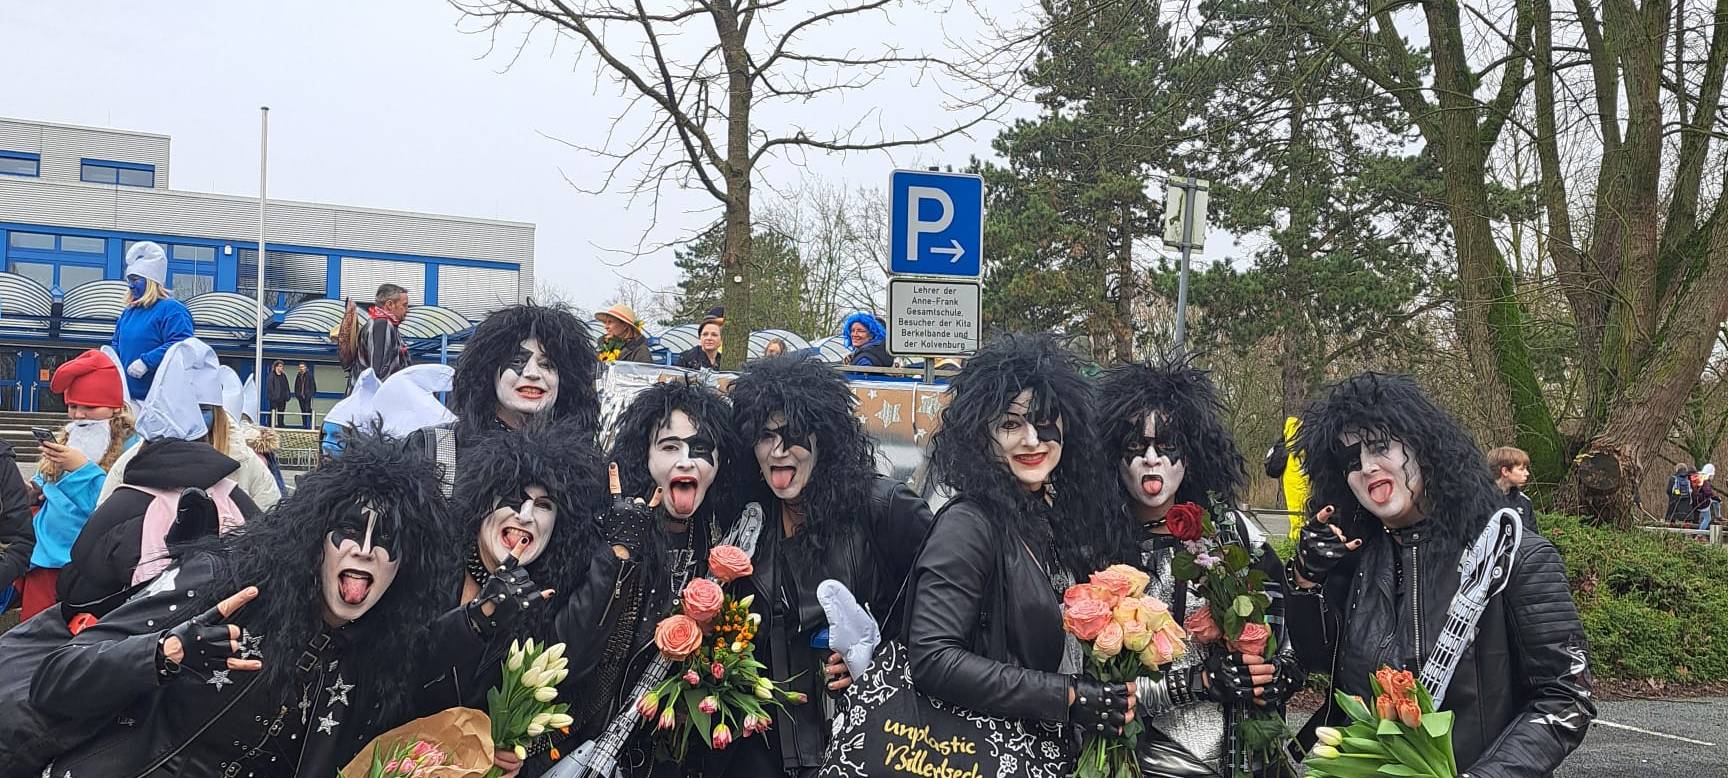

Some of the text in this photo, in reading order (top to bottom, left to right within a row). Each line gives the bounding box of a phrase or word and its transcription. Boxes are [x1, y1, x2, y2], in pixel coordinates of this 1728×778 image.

[907, 186, 955, 261] P
[913, 285, 957, 295] Lehrer der
[911, 296, 959, 306] Anne-Frank
[898, 317, 972, 328] Besucher der Kita
[901, 328, 969, 339] Berkelbande und
[904, 340, 966, 351] der Kolvenburg
[884, 719, 977, 756] unplastic
